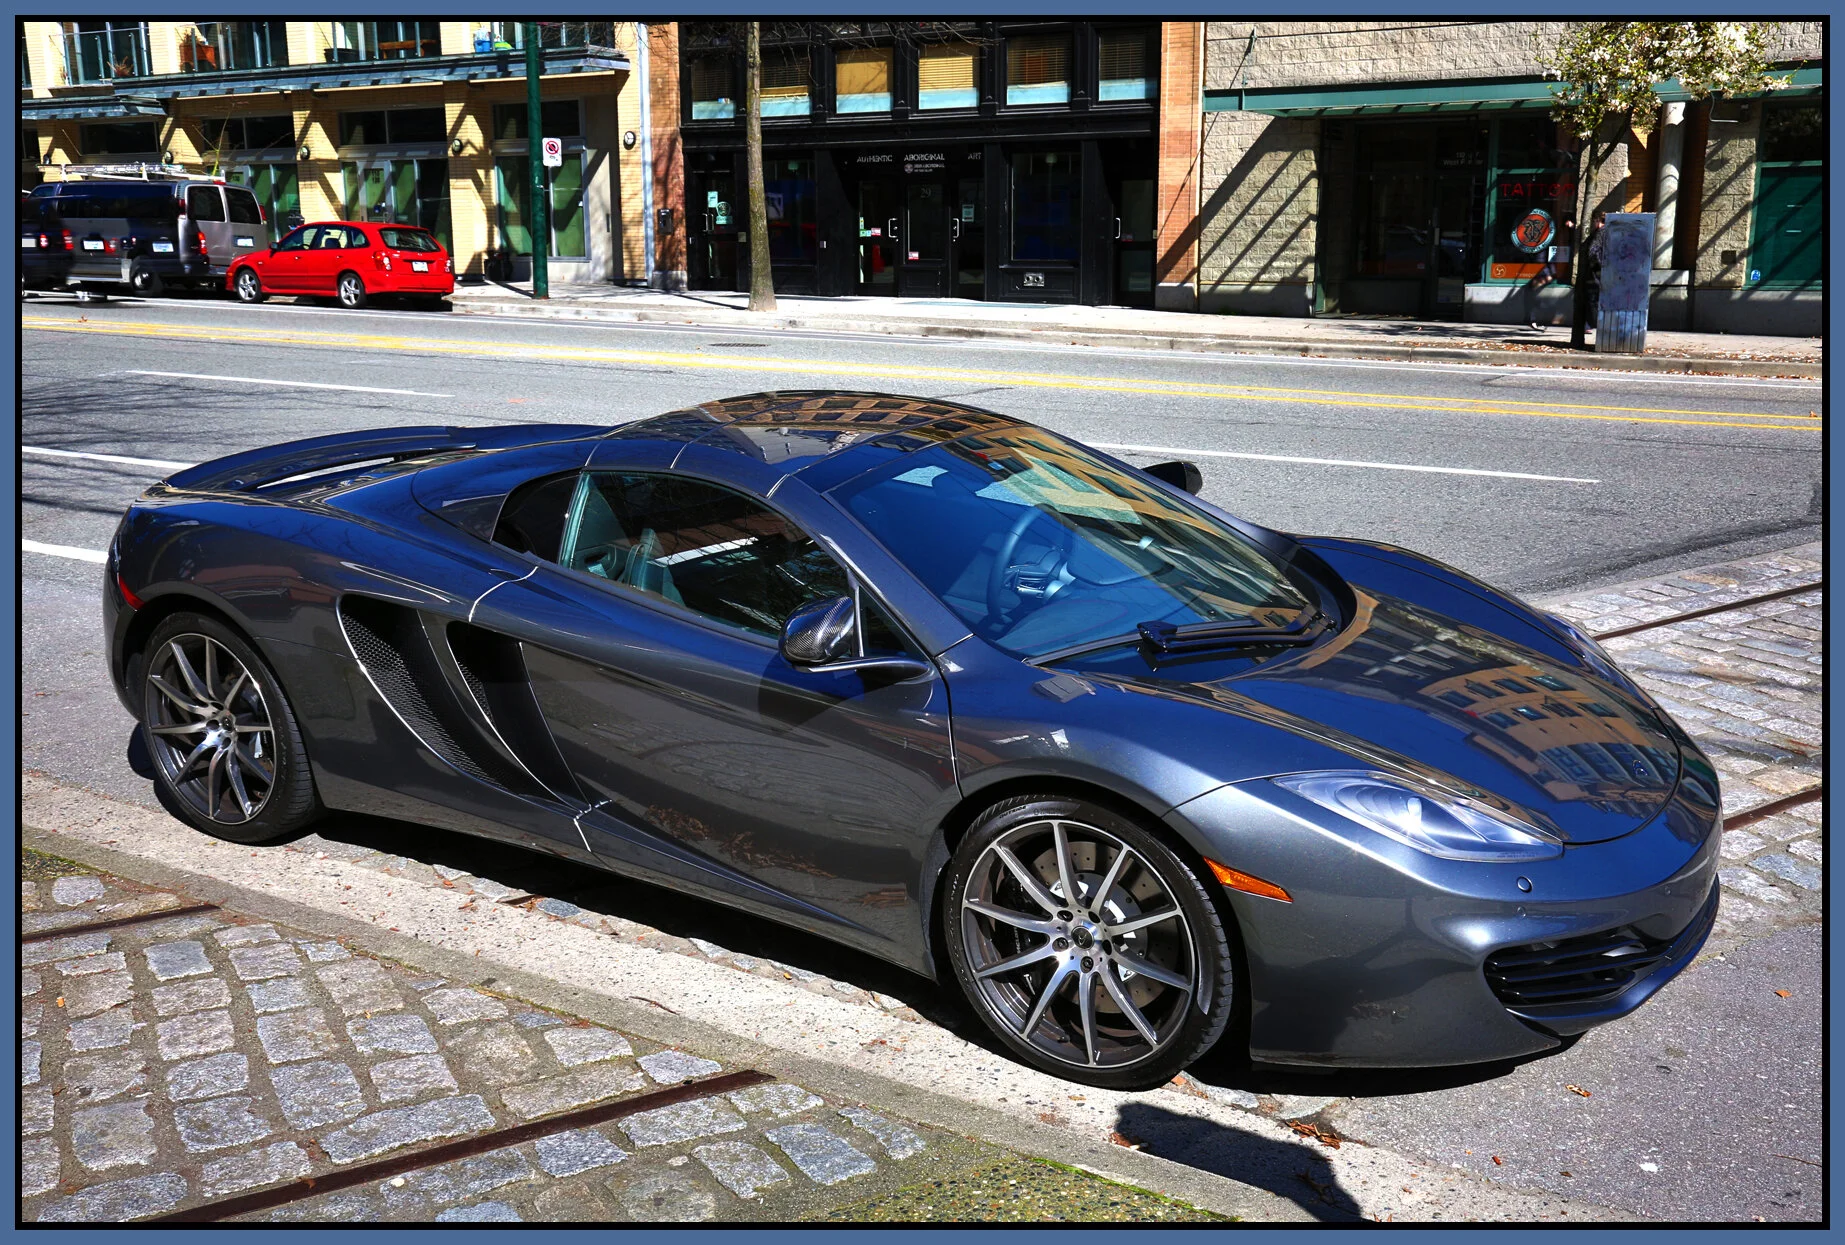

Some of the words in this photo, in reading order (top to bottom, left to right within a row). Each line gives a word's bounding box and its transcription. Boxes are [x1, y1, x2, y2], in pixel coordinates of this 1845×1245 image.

[856, 154, 893, 164] AUTHENTIC
[903, 153, 945, 161] ABORIGINAL
[967, 152, 982, 160] ART
[920, 187, 932, 199] 29
[1500, 182, 1576, 197] TATTOO
